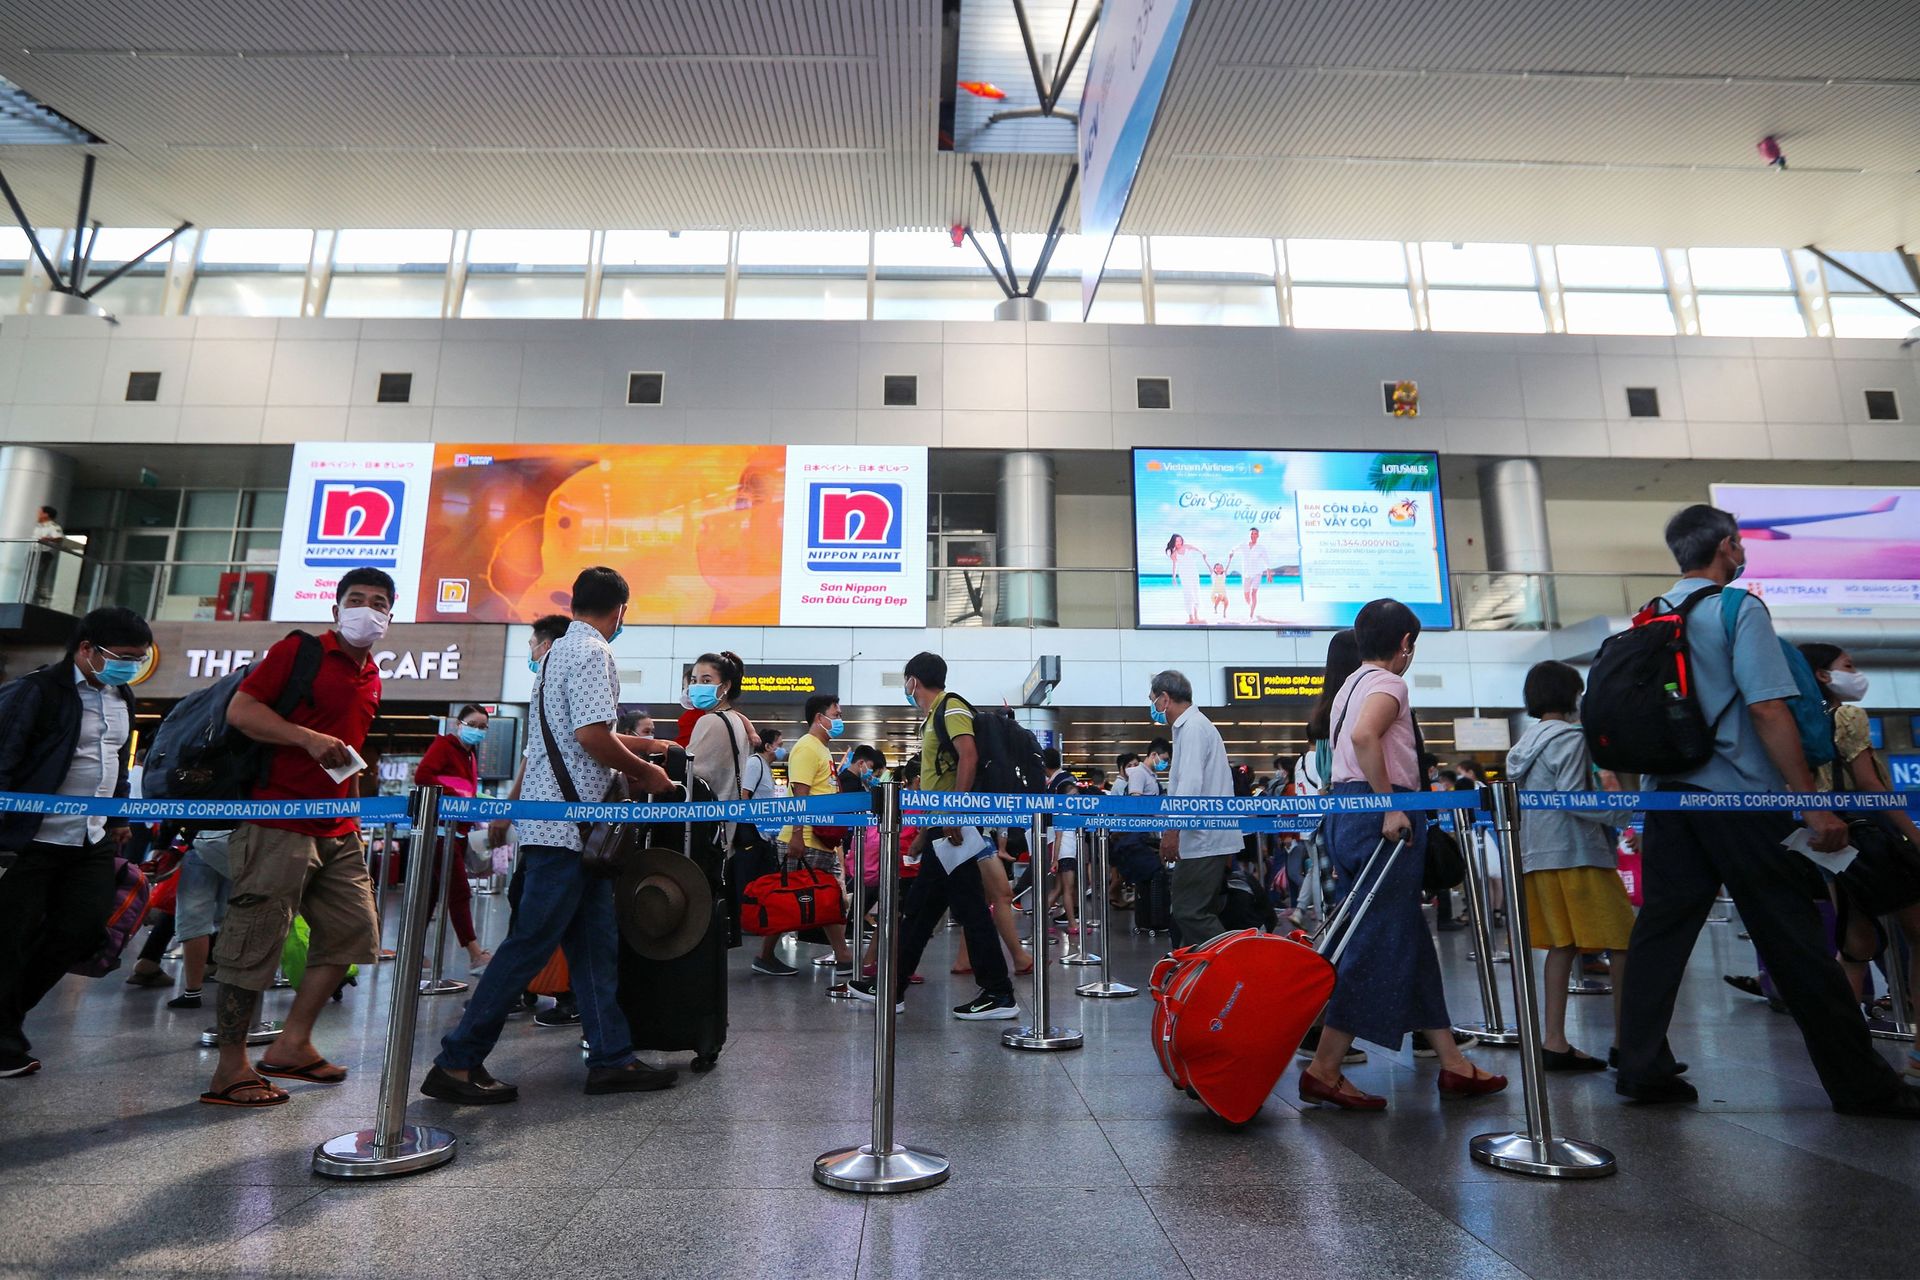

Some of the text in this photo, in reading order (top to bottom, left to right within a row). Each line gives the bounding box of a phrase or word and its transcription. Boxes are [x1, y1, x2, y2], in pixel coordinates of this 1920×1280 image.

[803, 464, 851, 472] 日本ペイント
[1163, 462, 1234, 473] Vietnam Airlines
[1382, 464, 1428, 474] LOTUSMILES
[1179, 490, 1242, 511] Côn Đảo
[1323, 501, 1378, 513] CÔN ĐẢO
[1259, 506, 1282, 523] gọi
[1350, 518, 1371, 529] GỌI
[306, 548, 355, 556] NIPPON
[808, 551, 901, 560] NIPPON PAINT
[820, 583, 887, 593] Sơn Nippon
[801, 595, 824, 604] Sơn
[884, 596, 908, 606] Đẹp
[187, 644, 460, 680] THE CAFÉ
[741, 675, 813, 685] ÒNG CHỜ QUỐC NỘI
[1264, 675, 1292, 685] PHÒNG
[1292, 675, 1310, 685] CHỜ
[1264, 686, 1299, 695] Domestic
[901, 791, 940, 807] HÀNG
[943, 791, 989, 808] KHÔNG
[994, 794, 1023, 811] VIỆT
[1025, 796, 1055, 809] NAM
[1065, 797, 1100, 810] CTCP
[1160, 796, 1392, 811] AIRPORTS CORPORATION OF VIETNAM
[1541, 793, 1567, 809] VIỆT
[1570, 794, 1598, 806] NAM
[1607, 794, 1640, 807] CTCP
[1680, 794, 1908, 807] AIRPORTS CORPORATION OF VIETNAM
[14, 799, 44, 813] NAM
[54, 801, 88, 815] CTCP
[118, 800, 361, 816] AIRPORTS CORPORATION OF VIETNAM
[441, 799, 470, 812] NAM
[480, 802, 512, 815] CTCP
[564, 799, 807, 819] AIRPORTS CORPORATION OF VIETNAM
[797, 815, 834, 823] VIETNAM
[917, 816, 929, 825] TY
[930, 814, 955, 825] CẢNG
[956, 814, 981, 824] HÀNG
[982, 813, 1013, 824] KHÔNG
[1085, 818, 1239, 828] AIRPORTS CORPORATION OF VIETNAM
[1297, 816, 1321, 828] CÔNG
